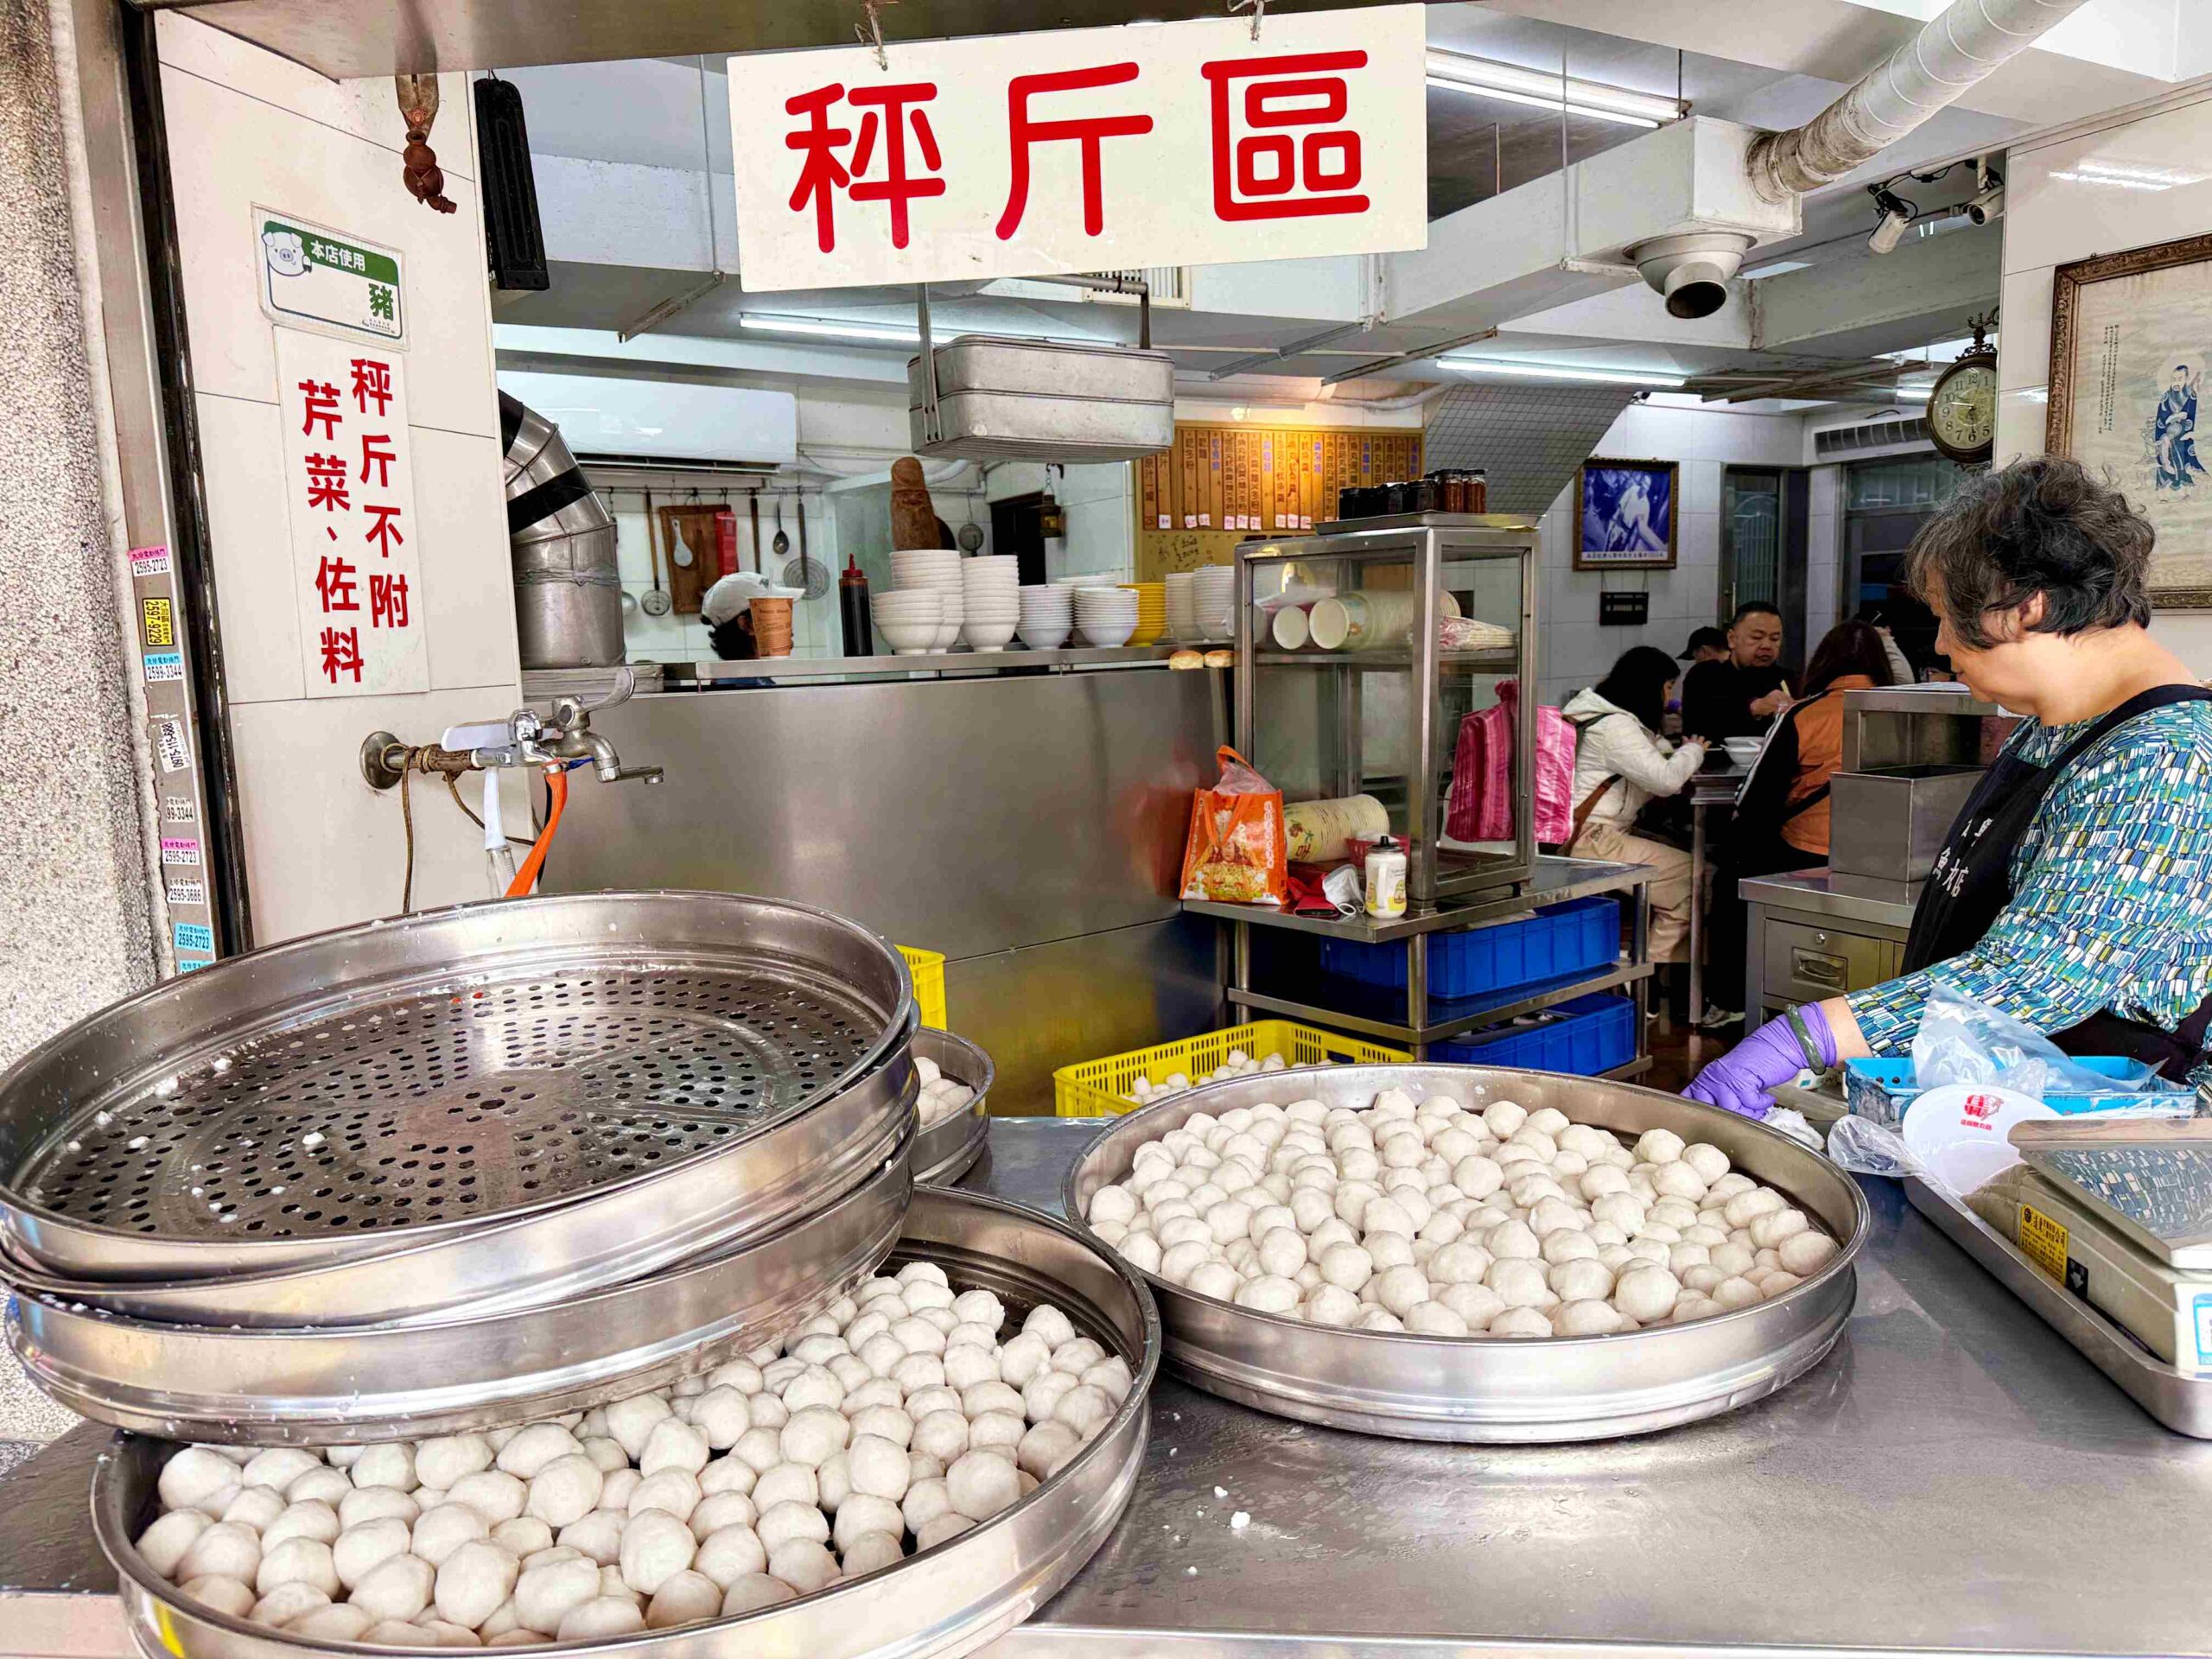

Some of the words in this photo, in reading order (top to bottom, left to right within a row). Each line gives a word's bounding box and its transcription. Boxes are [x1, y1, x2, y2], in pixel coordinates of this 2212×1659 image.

[785, 49, 1370, 253] 秤斤區
[310, 240, 365, 271] 本店使用
[368, 283, 394, 321] 豬
[1955, 380, 1964, 391] 11
[1967, 373, 1978, 385] 12
[1945, 392, 1955, 403] 10
[1942, 406, 1950, 417] 9
[1946, 421, 1953, 431] 8
[1982, 425, 1990, 436] 5
[1955, 430, 1963, 441] 7
[1968, 432, 1976, 442] 6
[350, 358, 409, 628] 秤斤不附
[298, 378, 365, 683] 芹菜、佐料
[135, 557, 168, 574] 2595-2723
[147, 664, 182, 679] 2599-3344
[164, 850, 197, 863] 2595-2723
[178, 933, 210, 950] 2595-2723
